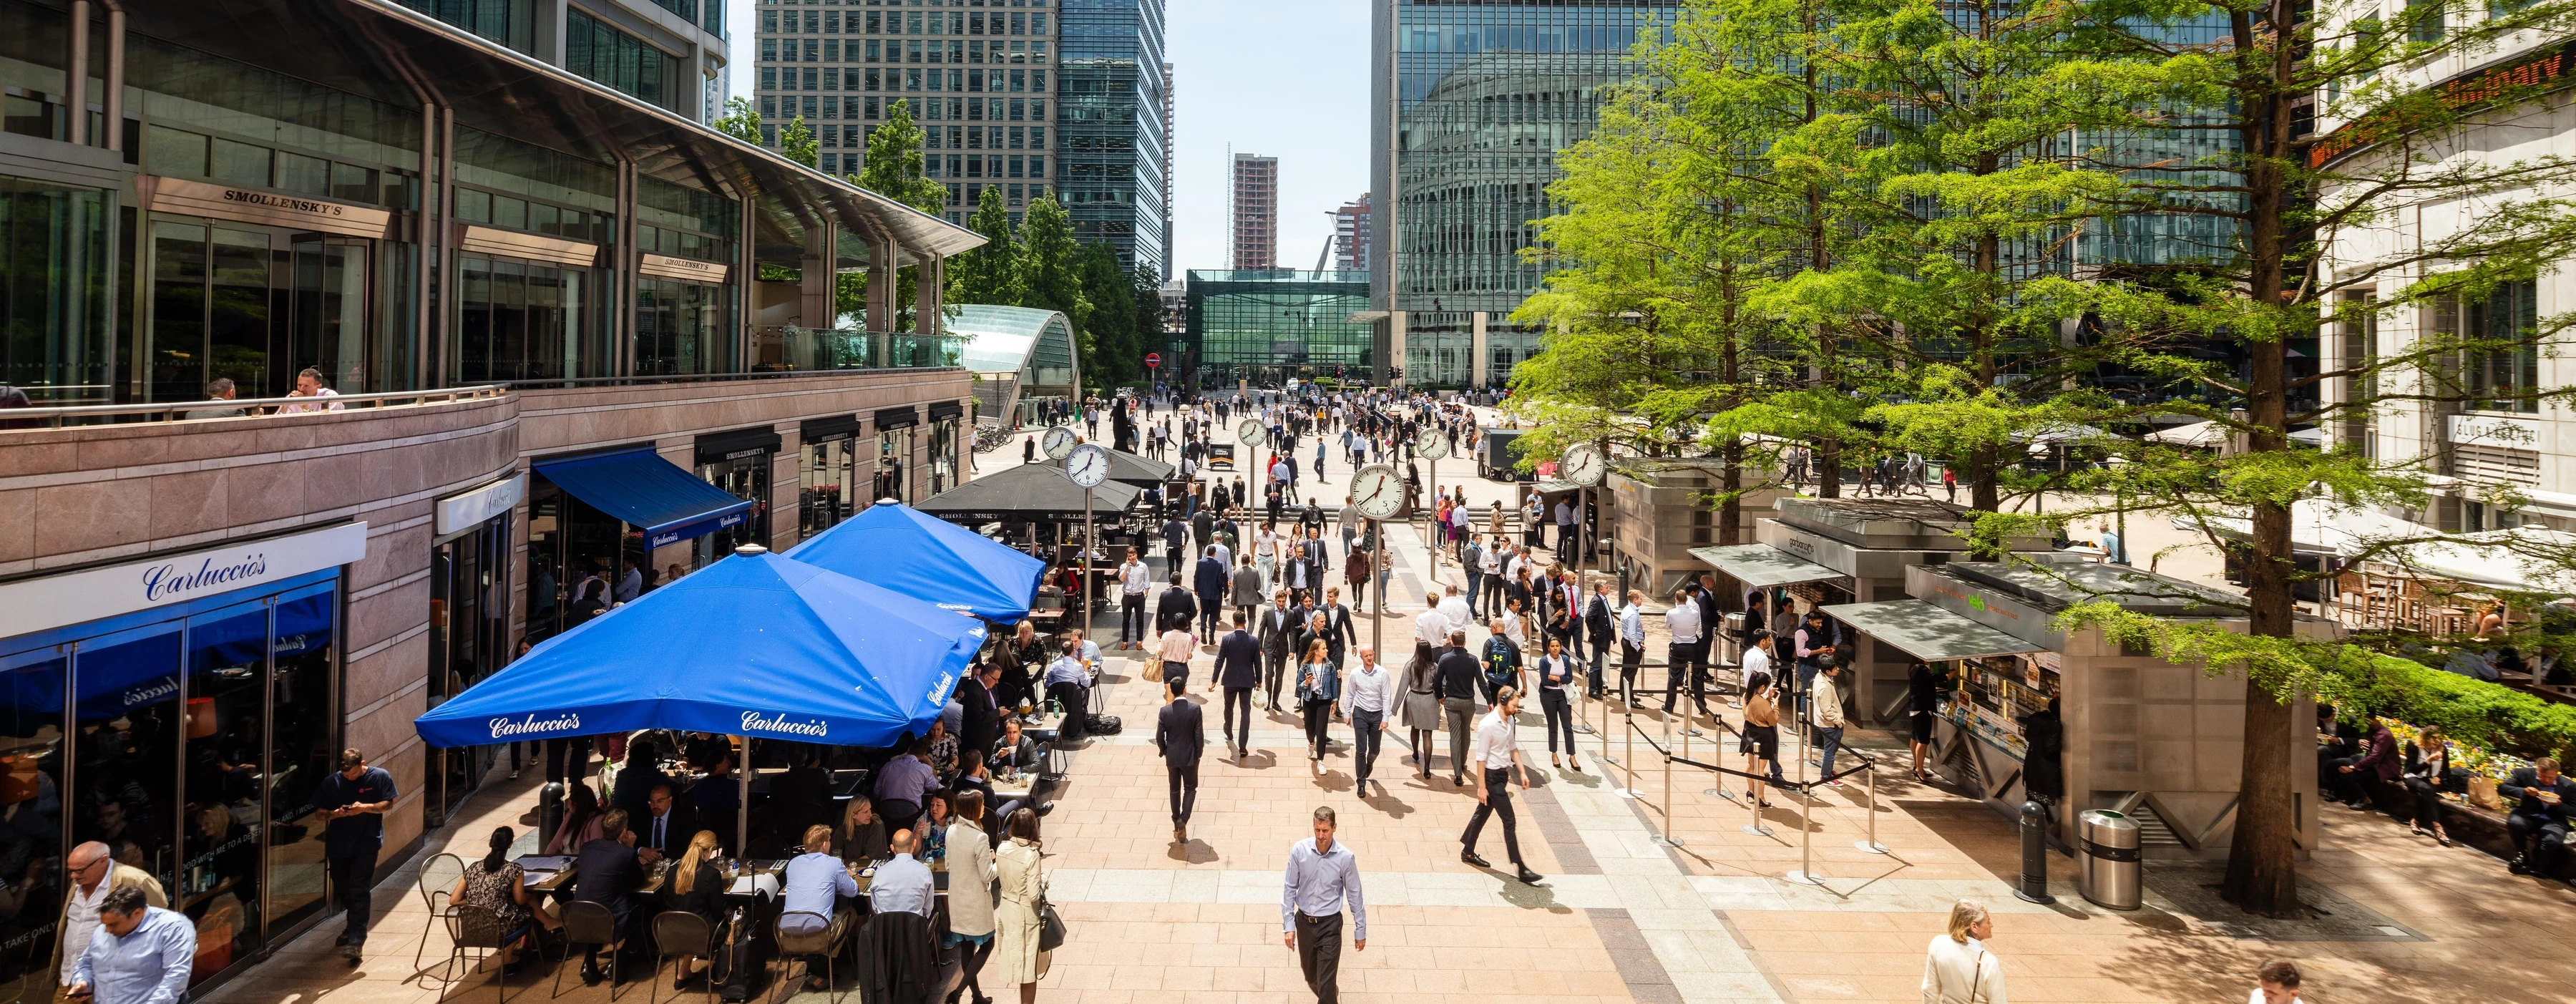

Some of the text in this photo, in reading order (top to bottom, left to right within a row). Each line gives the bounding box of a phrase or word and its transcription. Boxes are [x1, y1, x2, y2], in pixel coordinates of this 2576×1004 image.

[224, 190, 343, 215] SMOLLENSKY'S
[665, 258, 708, 270] SMOLLENSKY'S
[726, 447, 764, 460] SMOLLENSKY'S
[720, 515, 741, 527] Carluccio's
[653, 532, 678, 547] Carluccio's
[143, 553, 265, 601] Carluccio's
[489, 713, 580, 739] Carluccio's
[741, 711, 827, 736] Carluccio's
[4, 932, 29, 949] TAKE
[31, 920, 57, 938] ONLY
[197, 852, 214, 864] WITH
[215, 844, 226, 855] ME
[228, 839, 236, 850] TO
